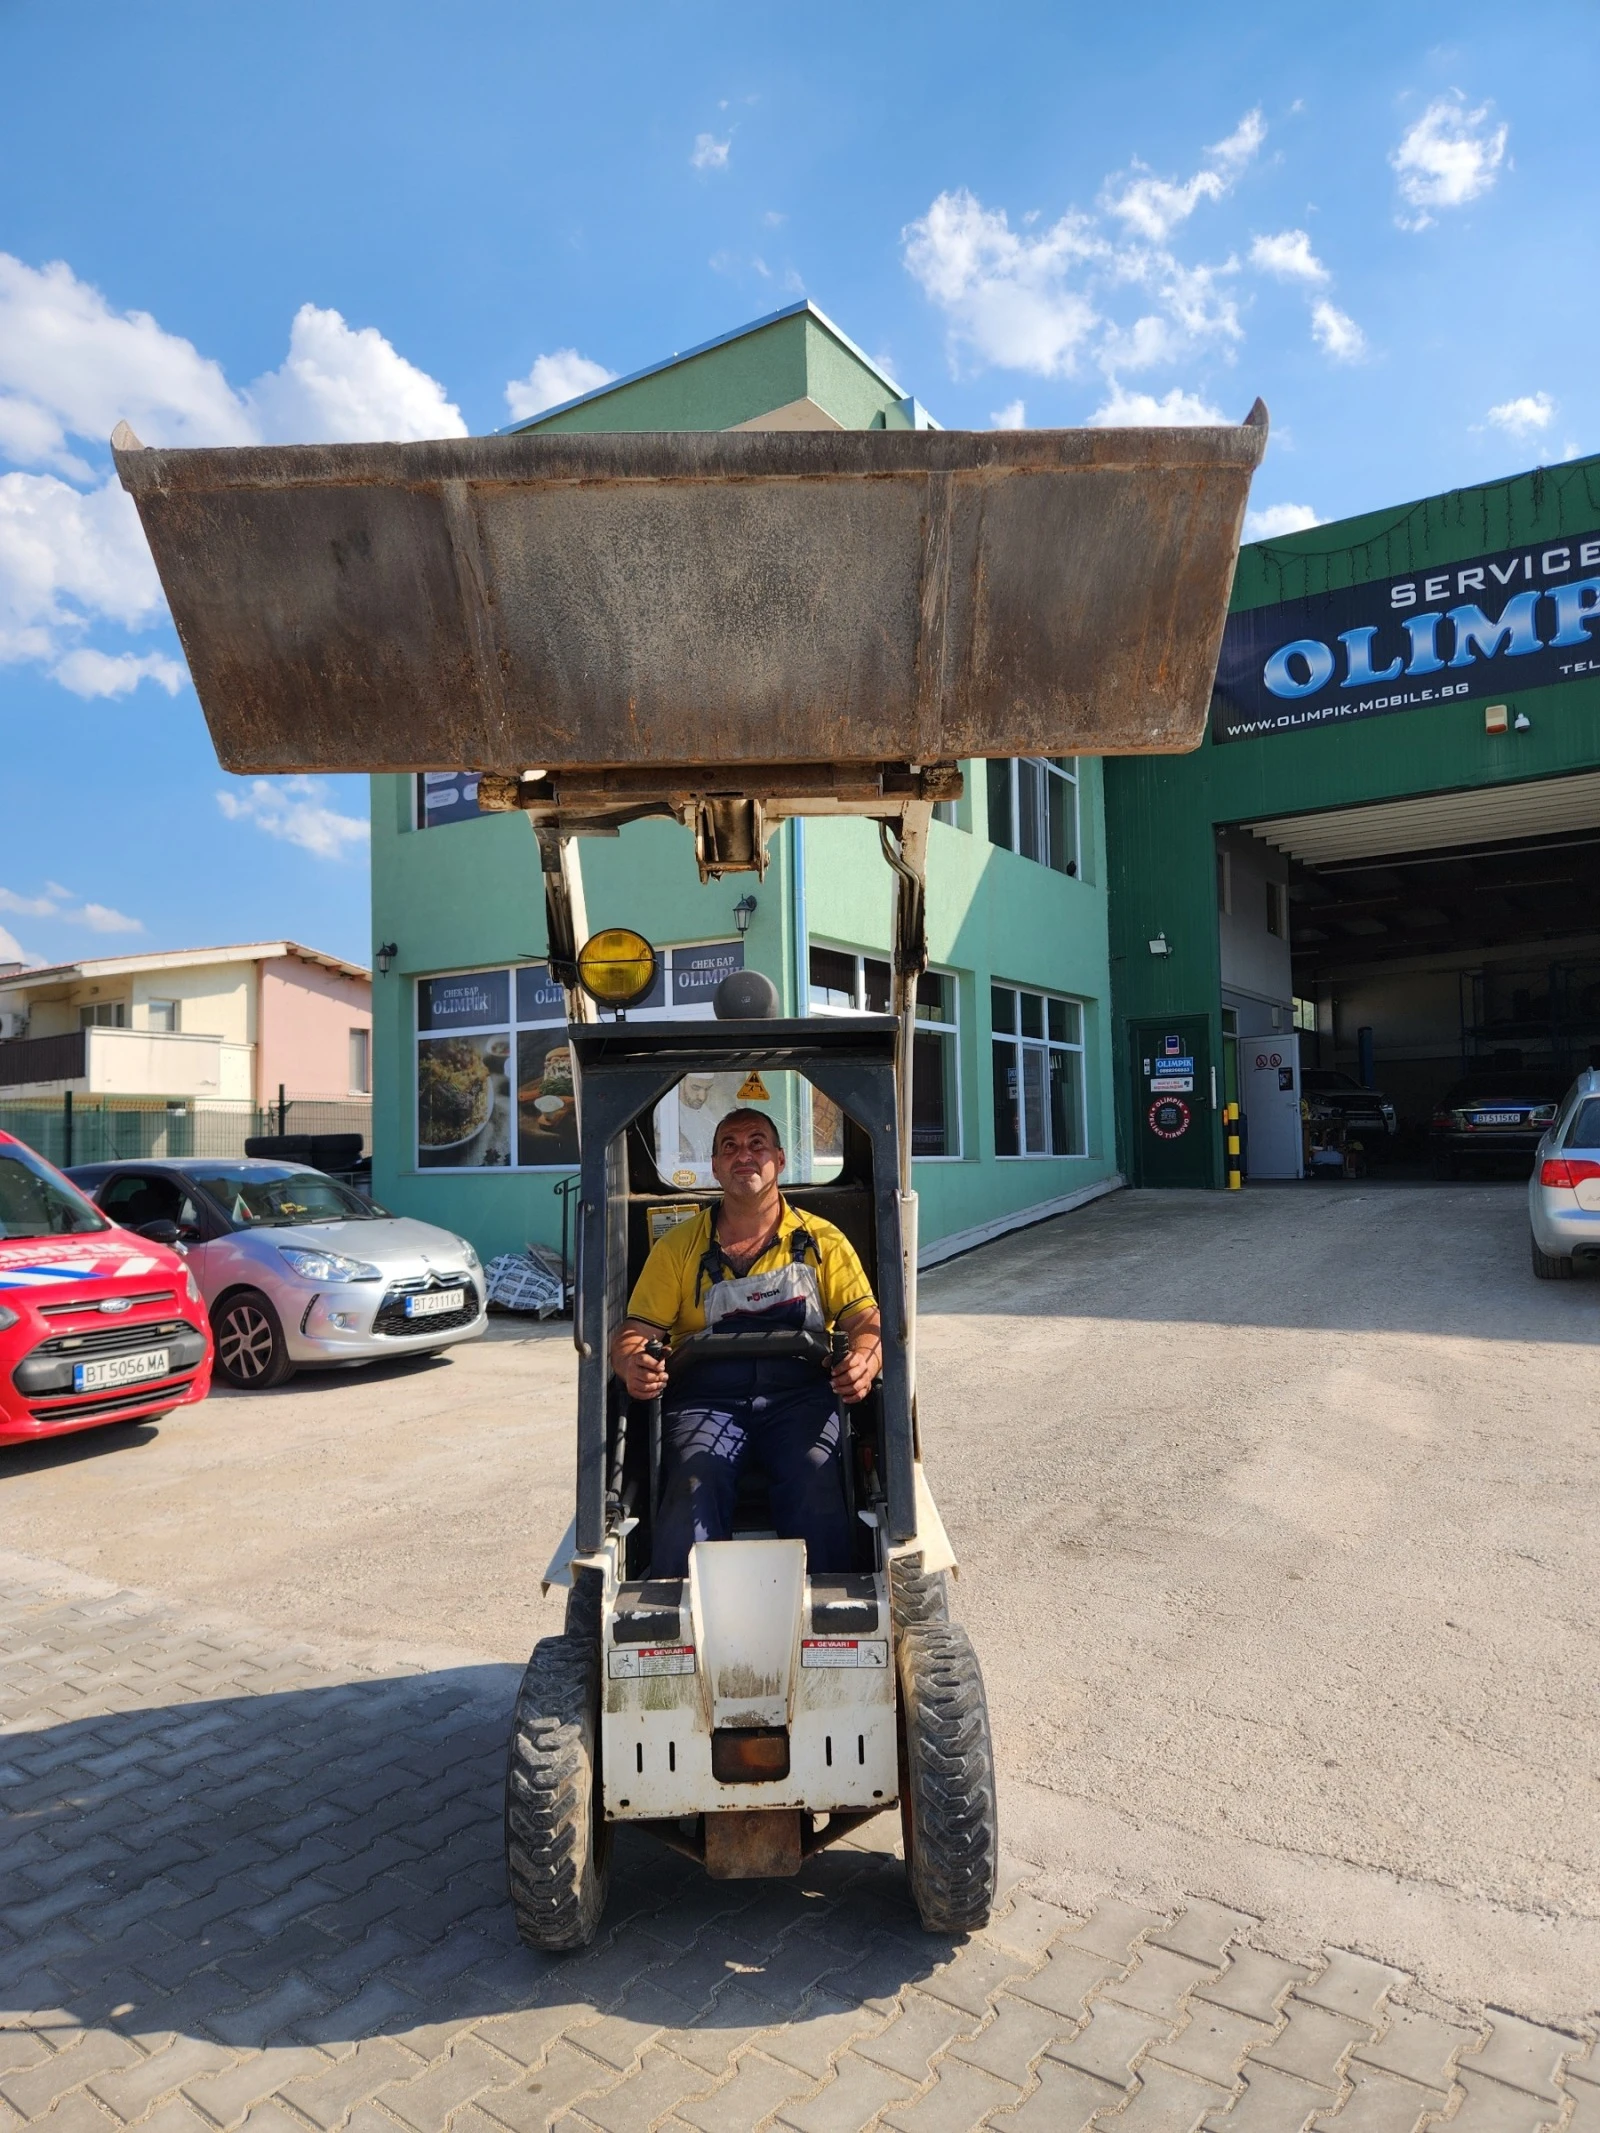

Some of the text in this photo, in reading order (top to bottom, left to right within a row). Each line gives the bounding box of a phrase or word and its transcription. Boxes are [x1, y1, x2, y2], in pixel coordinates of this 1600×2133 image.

[1390, 541, 1600, 610] SERVICE
[1263, 576, 1600, 699] OLIMP
[1227, 682, 1469, 735] WWW.OLIMPIK.MOBILE.BG
[691, 956, 734, 970] СНЕК БАР
[433, 993, 488, 1014] OLIMPIK
[414, 1298, 426, 1310] BT
[428, 1294, 449, 1308] 2111
[86, 1354, 165, 1382] BT 5056 MA
